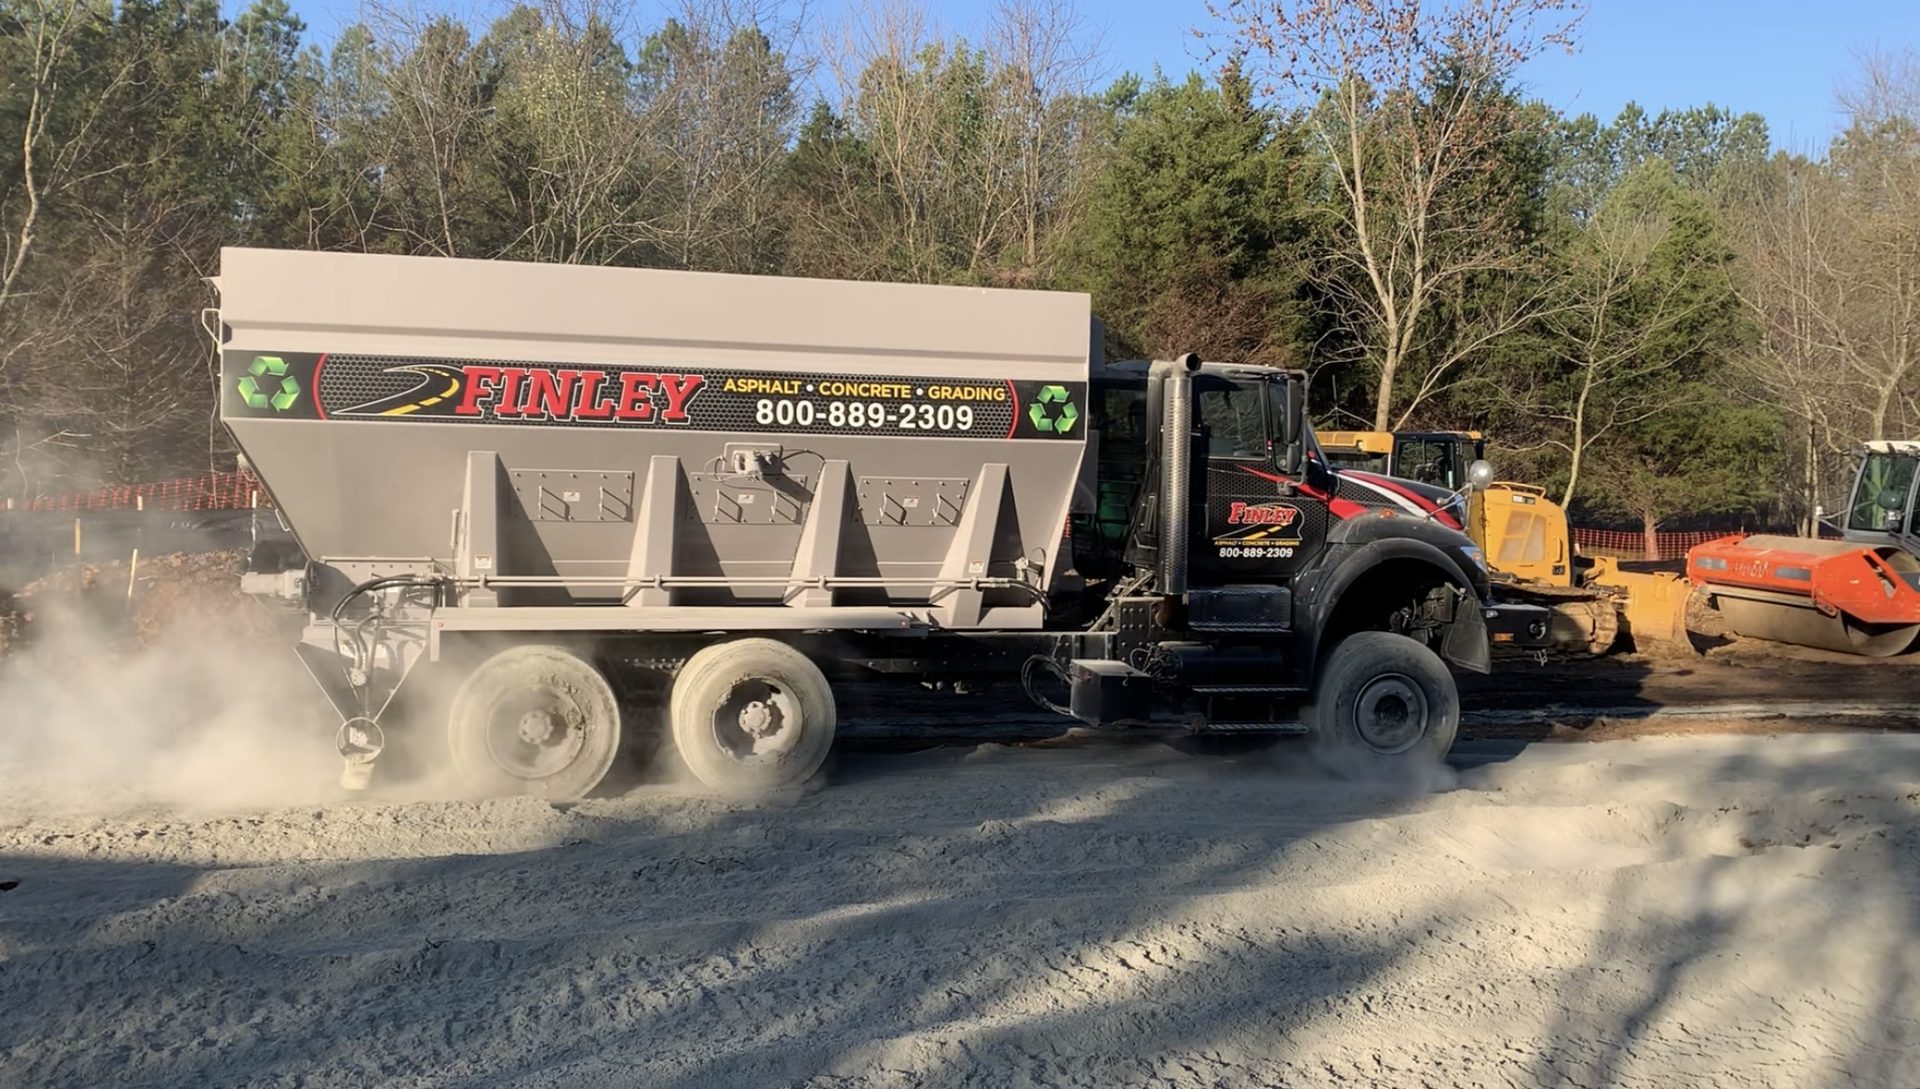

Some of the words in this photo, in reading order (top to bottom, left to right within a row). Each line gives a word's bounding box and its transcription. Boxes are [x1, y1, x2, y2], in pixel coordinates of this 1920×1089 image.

[455, 366, 706, 424] FINLEY
[724, 378, 802, 395] ASPHALT
[818, 382, 912, 399] CONCRETE
[927, 386, 1007, 402] GRADING
[756, 399, 974, 431] 800-889-2309
[1228, 501, 1297, 524] FINLEY
[1219, 548, 1293, 558] 800-889-2309
